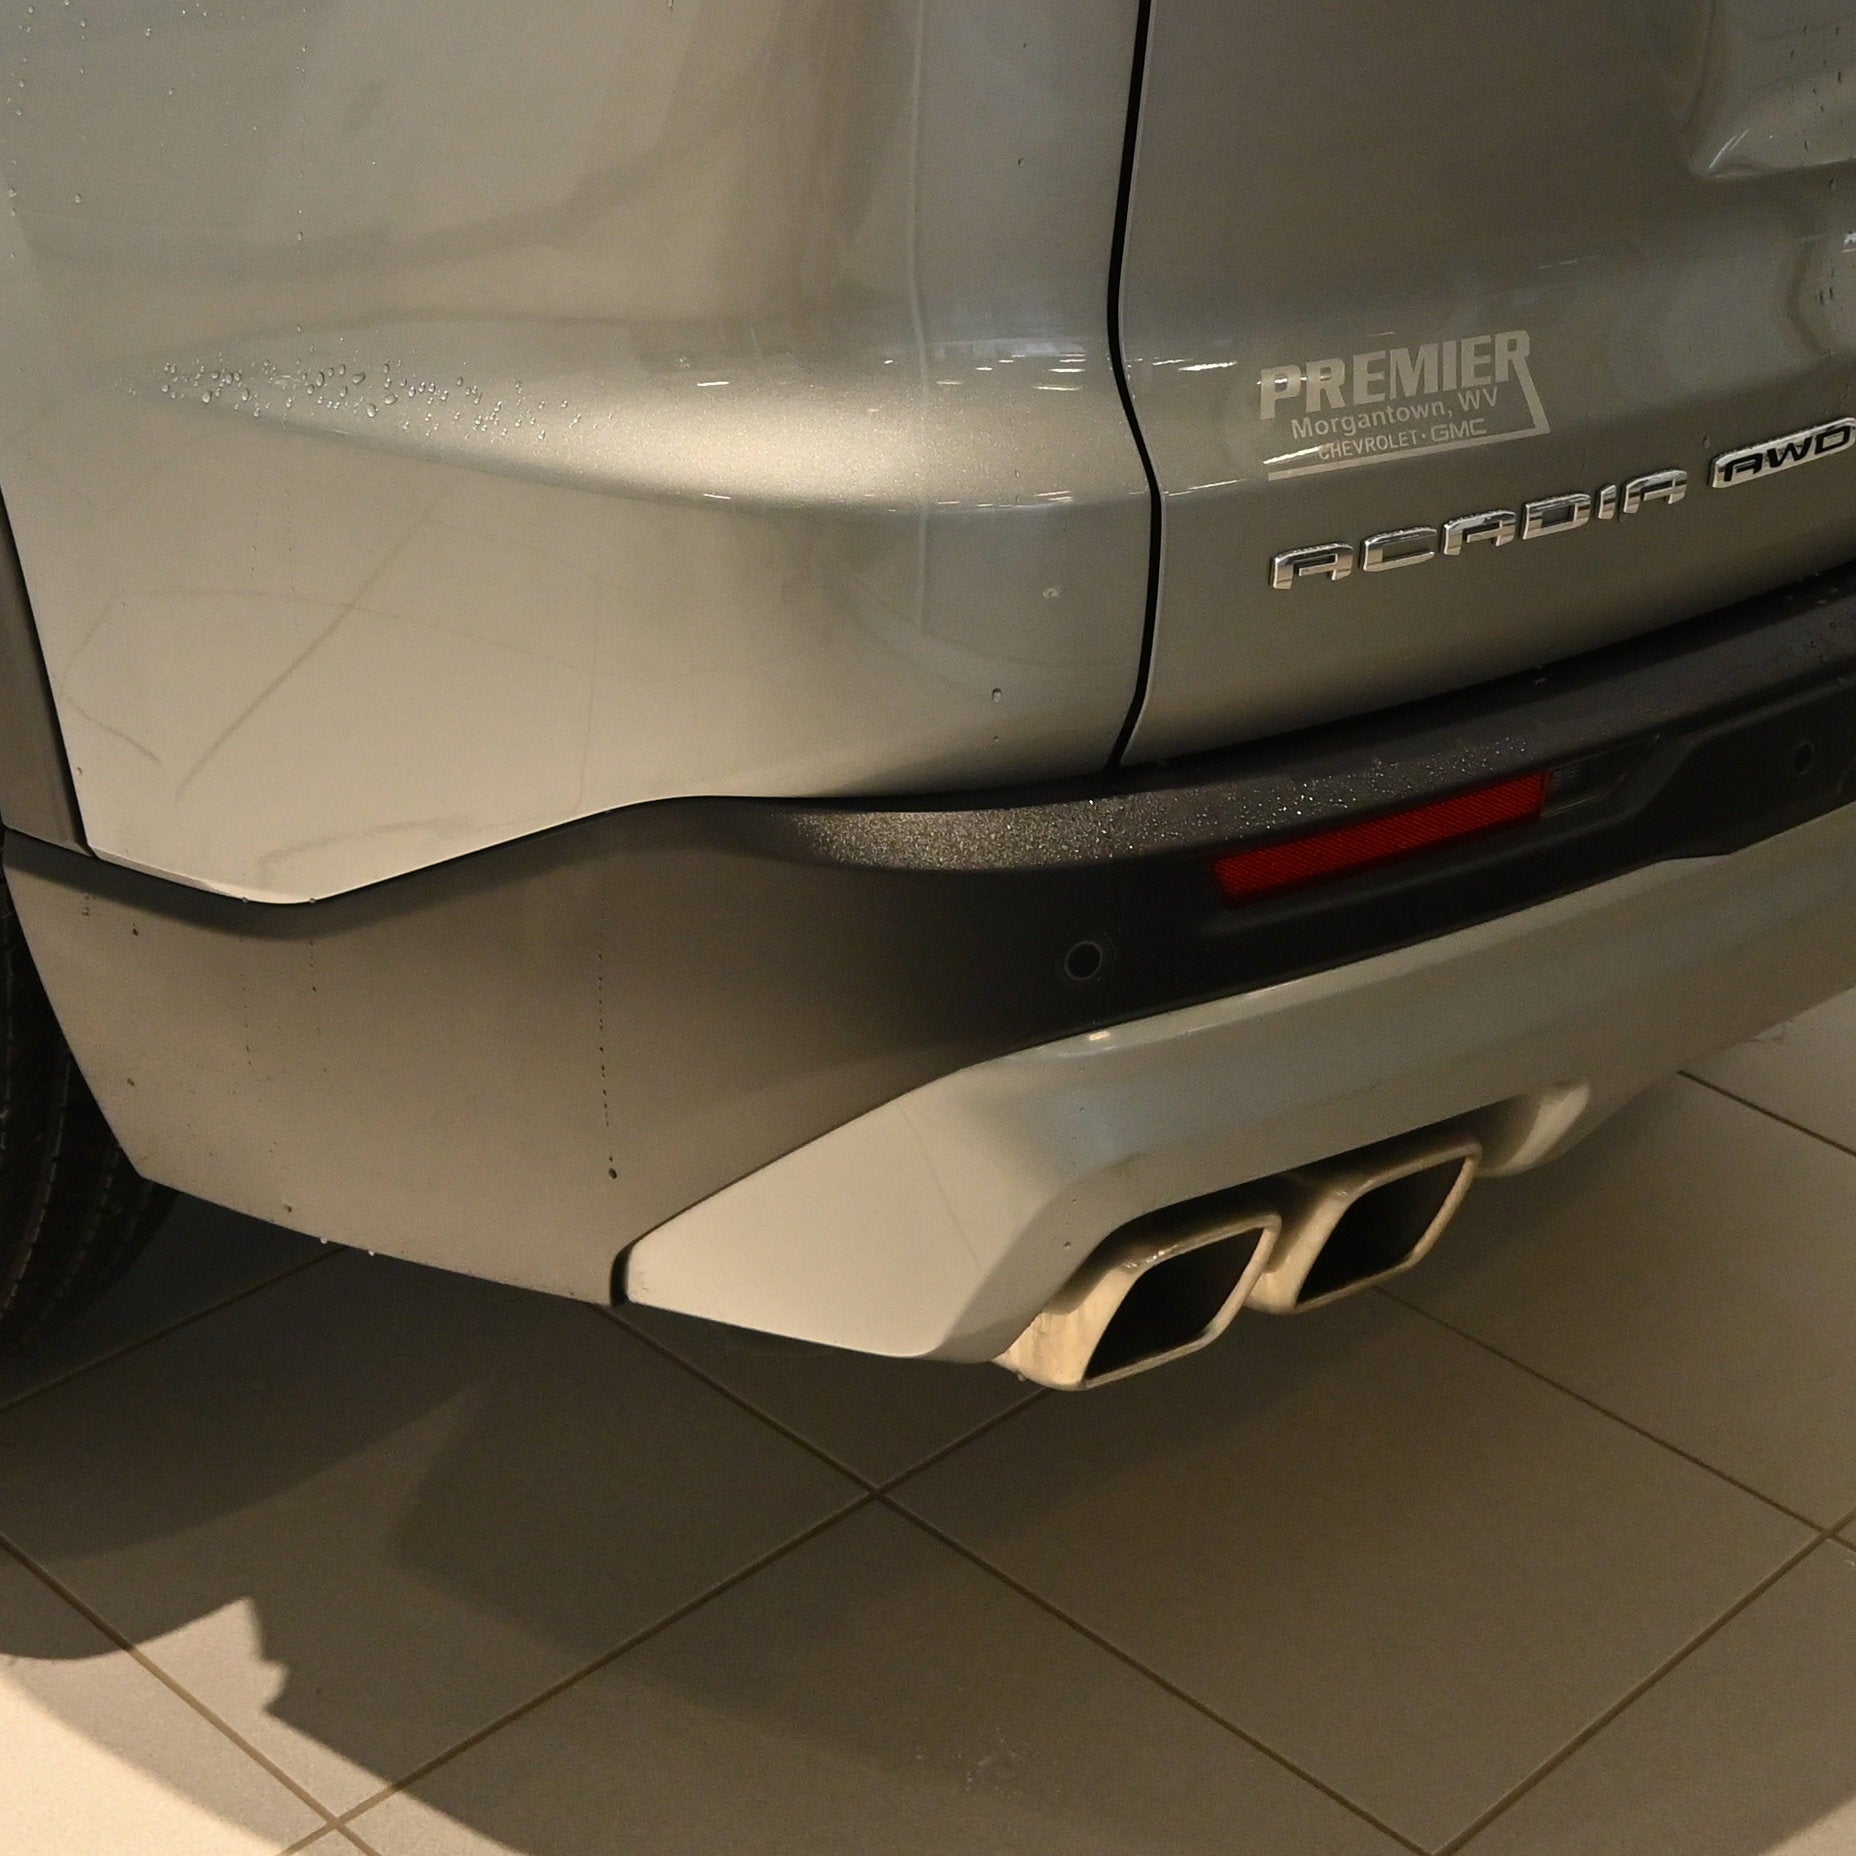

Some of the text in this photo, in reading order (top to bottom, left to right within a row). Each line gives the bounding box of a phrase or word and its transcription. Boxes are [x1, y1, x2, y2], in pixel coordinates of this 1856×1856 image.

[1259, 330, 1531, 421] PREMIER
[1290, 387, 1498, 440] Morgantown, WV
[1318, 418, 1487, 461] CHEVROLET GMC
[1269, 422, 1854, 591] ACADIA AWD
